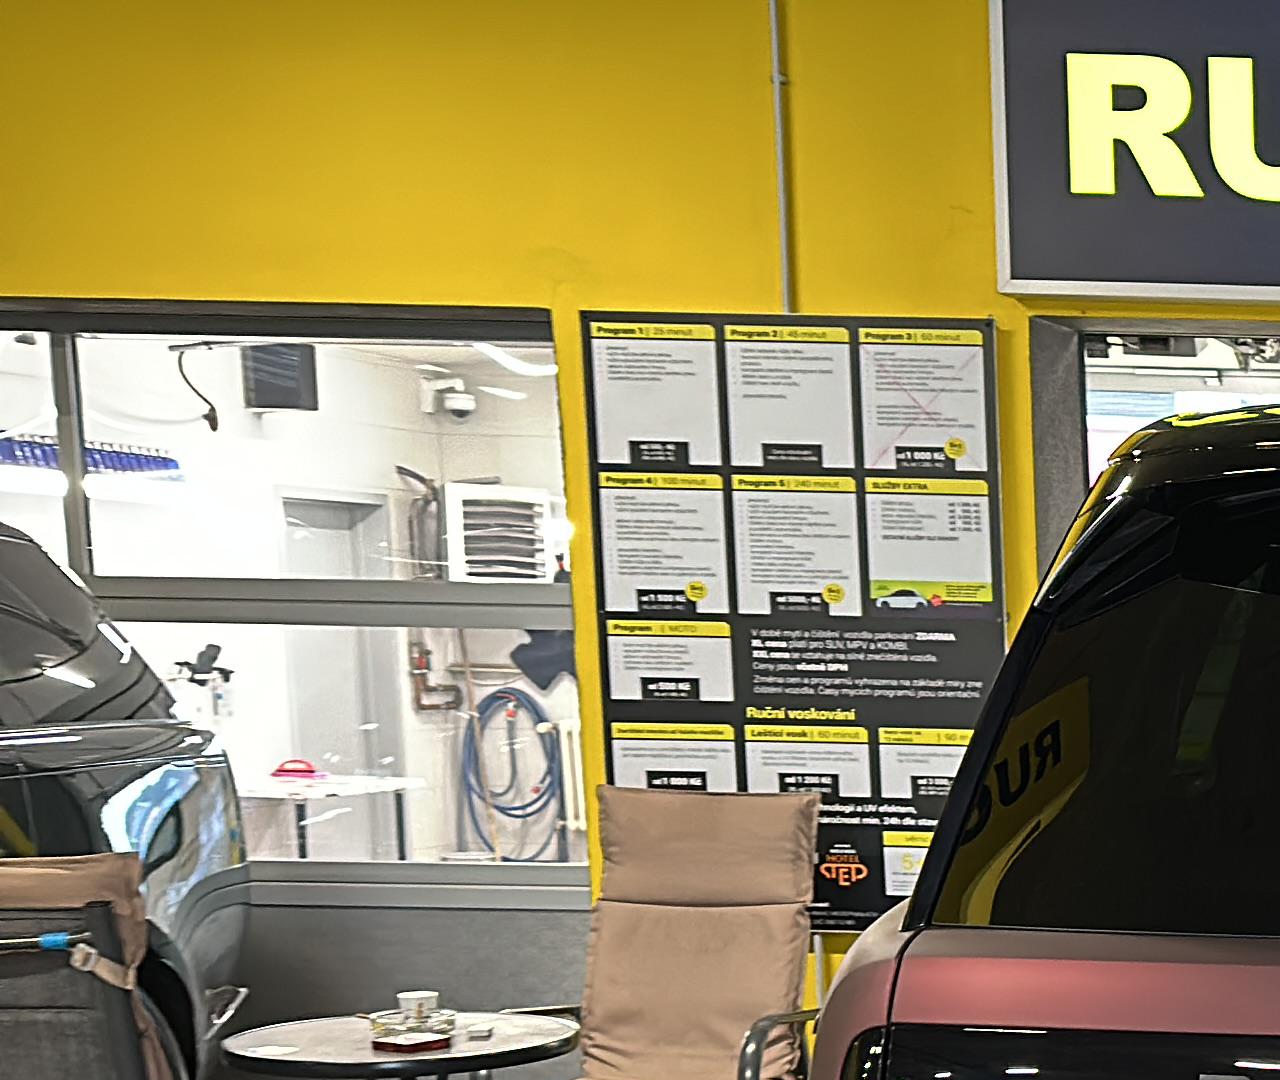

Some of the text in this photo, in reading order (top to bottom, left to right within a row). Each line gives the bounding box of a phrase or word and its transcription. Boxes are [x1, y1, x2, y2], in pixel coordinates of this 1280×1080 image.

[597, 326, 636, 337] Program
[731, 329, 770, 339] Program
[865, 332, 905, 342] Program
[606, 475, 646, 485] Program
[738, 478, 778, 488] Program
[613, 624, 652, 634] Program
[746, 706, 856, 720] Ruční voskování
[826, 854, 860, 863] HOTEL
